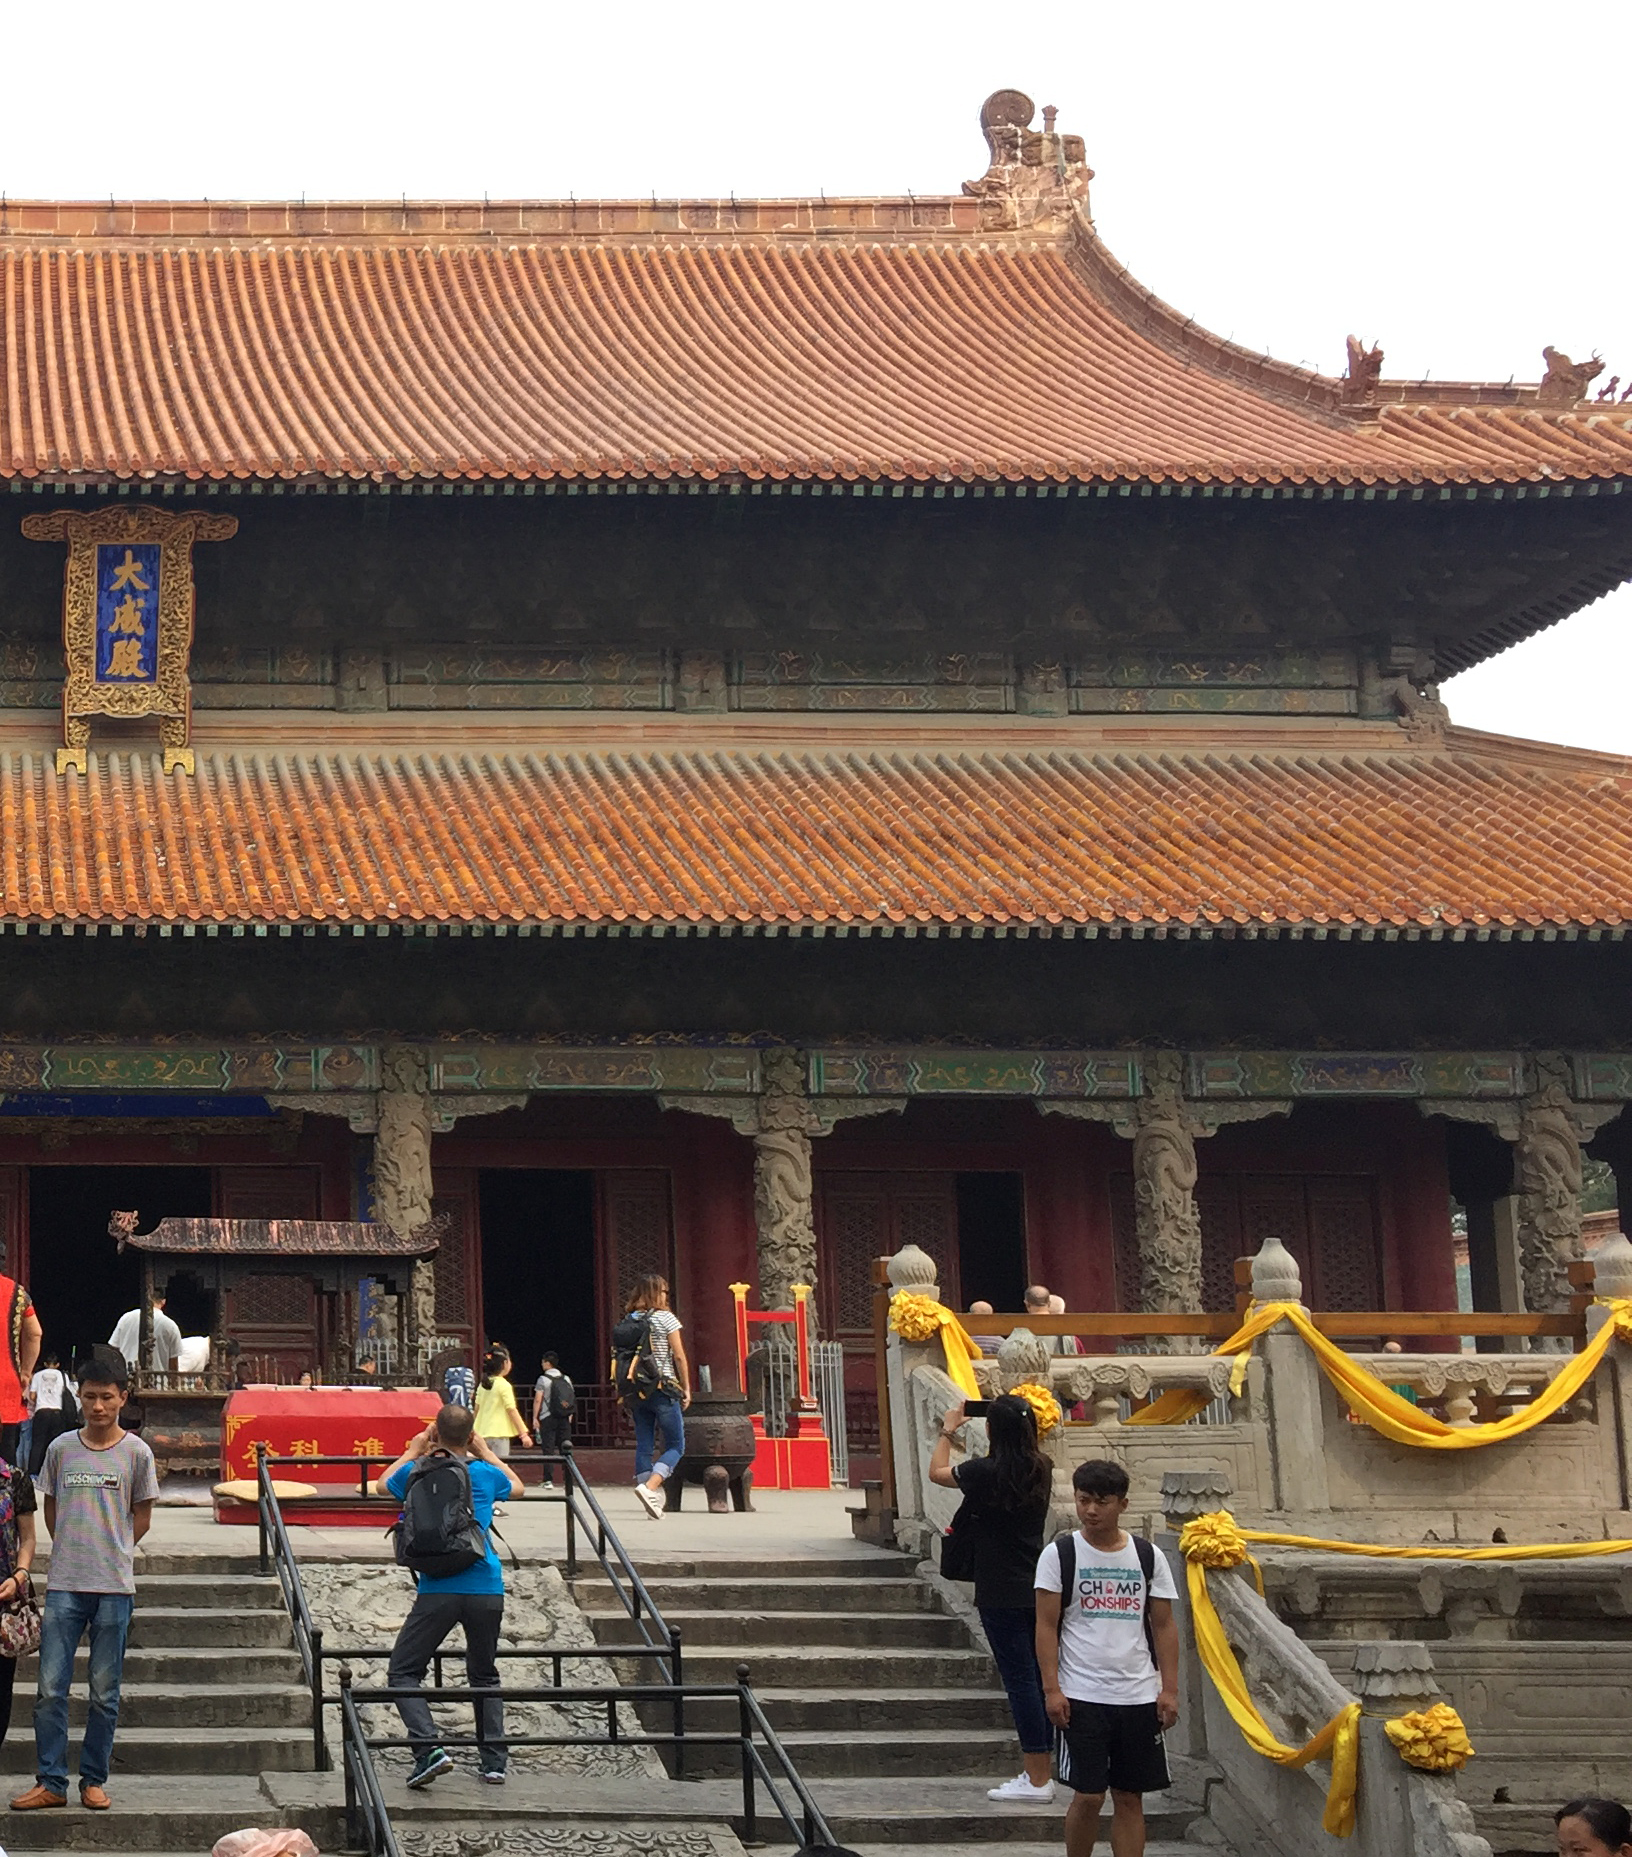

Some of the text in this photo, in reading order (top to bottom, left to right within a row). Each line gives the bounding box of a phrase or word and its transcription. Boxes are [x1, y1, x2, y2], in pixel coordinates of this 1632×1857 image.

[106, 549, 149, 678] 大成殿
[1080, 1596, 1141, 1611] IONSHIPS
